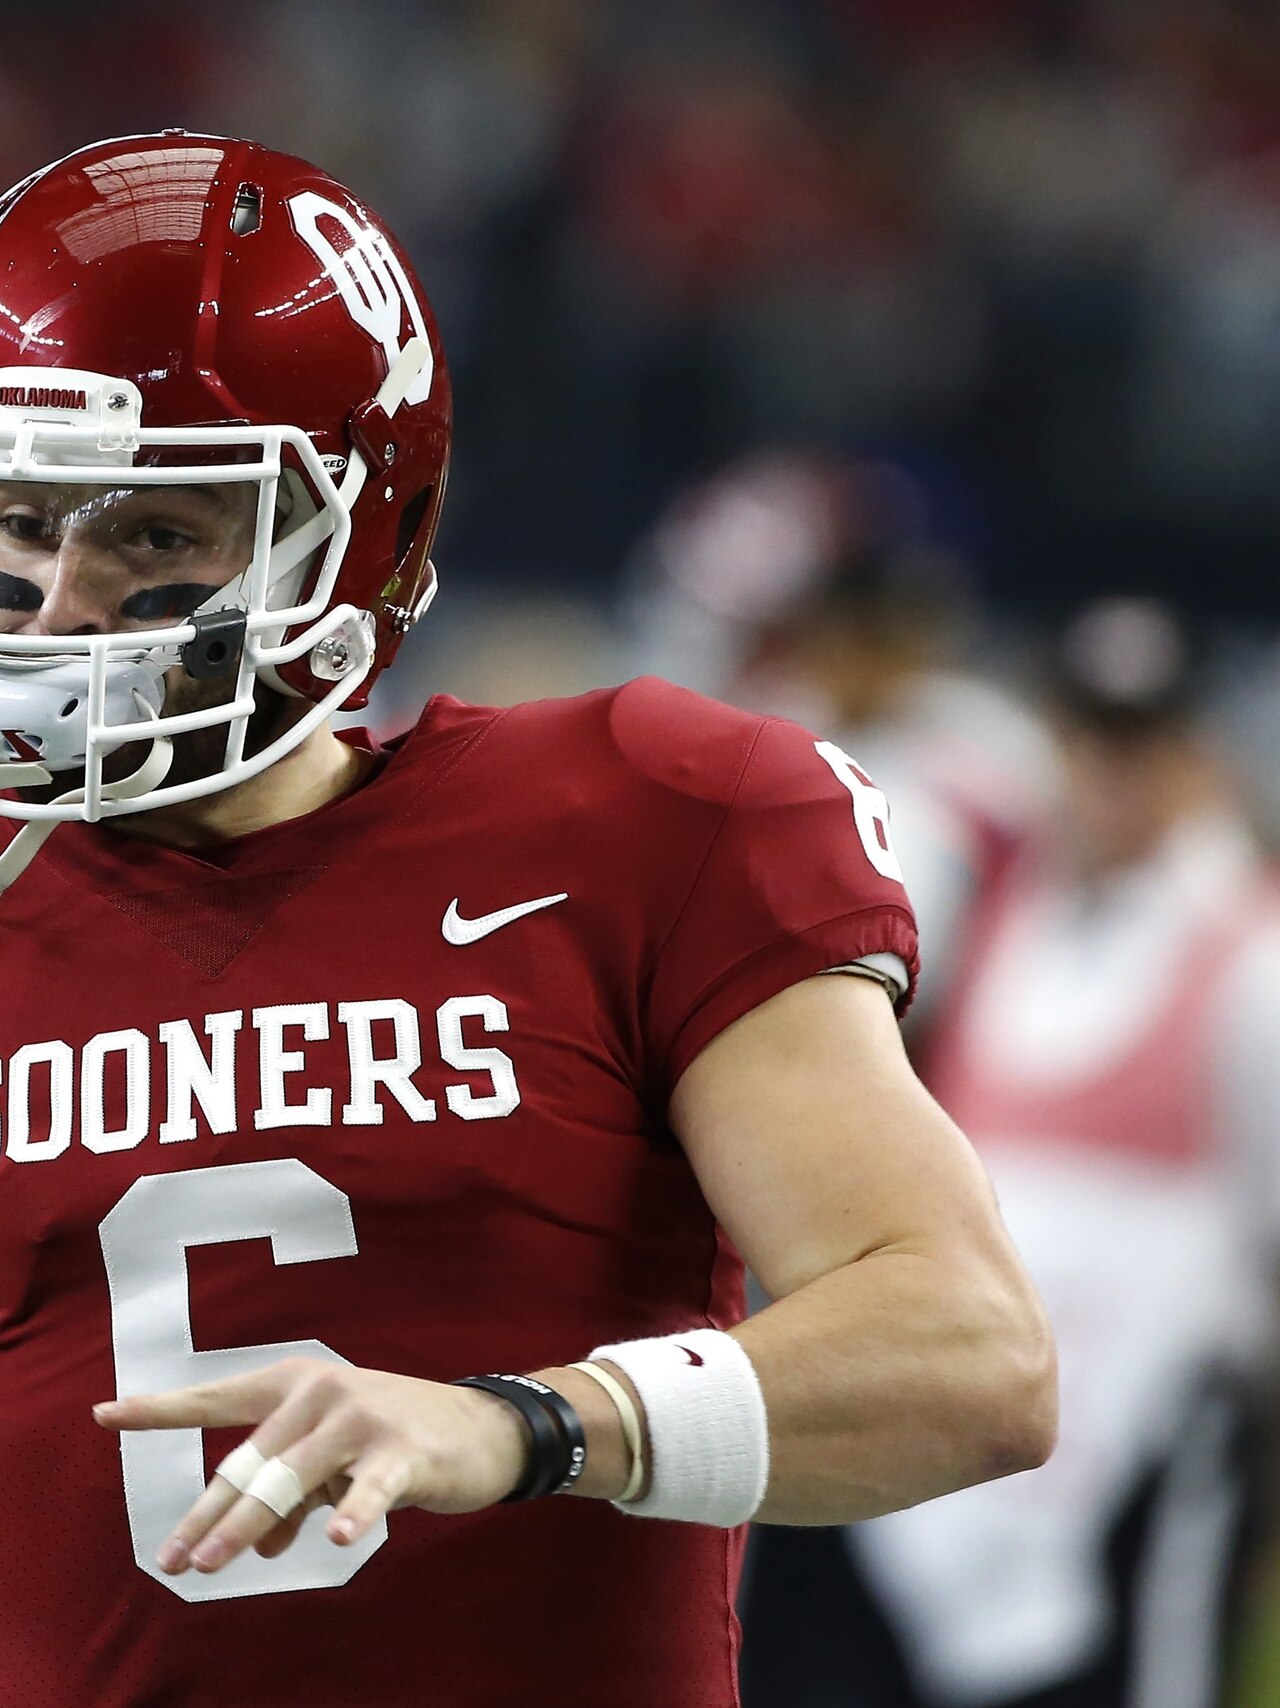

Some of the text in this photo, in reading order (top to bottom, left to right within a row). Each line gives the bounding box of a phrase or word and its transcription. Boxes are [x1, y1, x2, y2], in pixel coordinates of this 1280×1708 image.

[322, 458, 346, 469] EED
[813, 741, 904, 884] 6
[98, 1157, 390, 1603] 6
